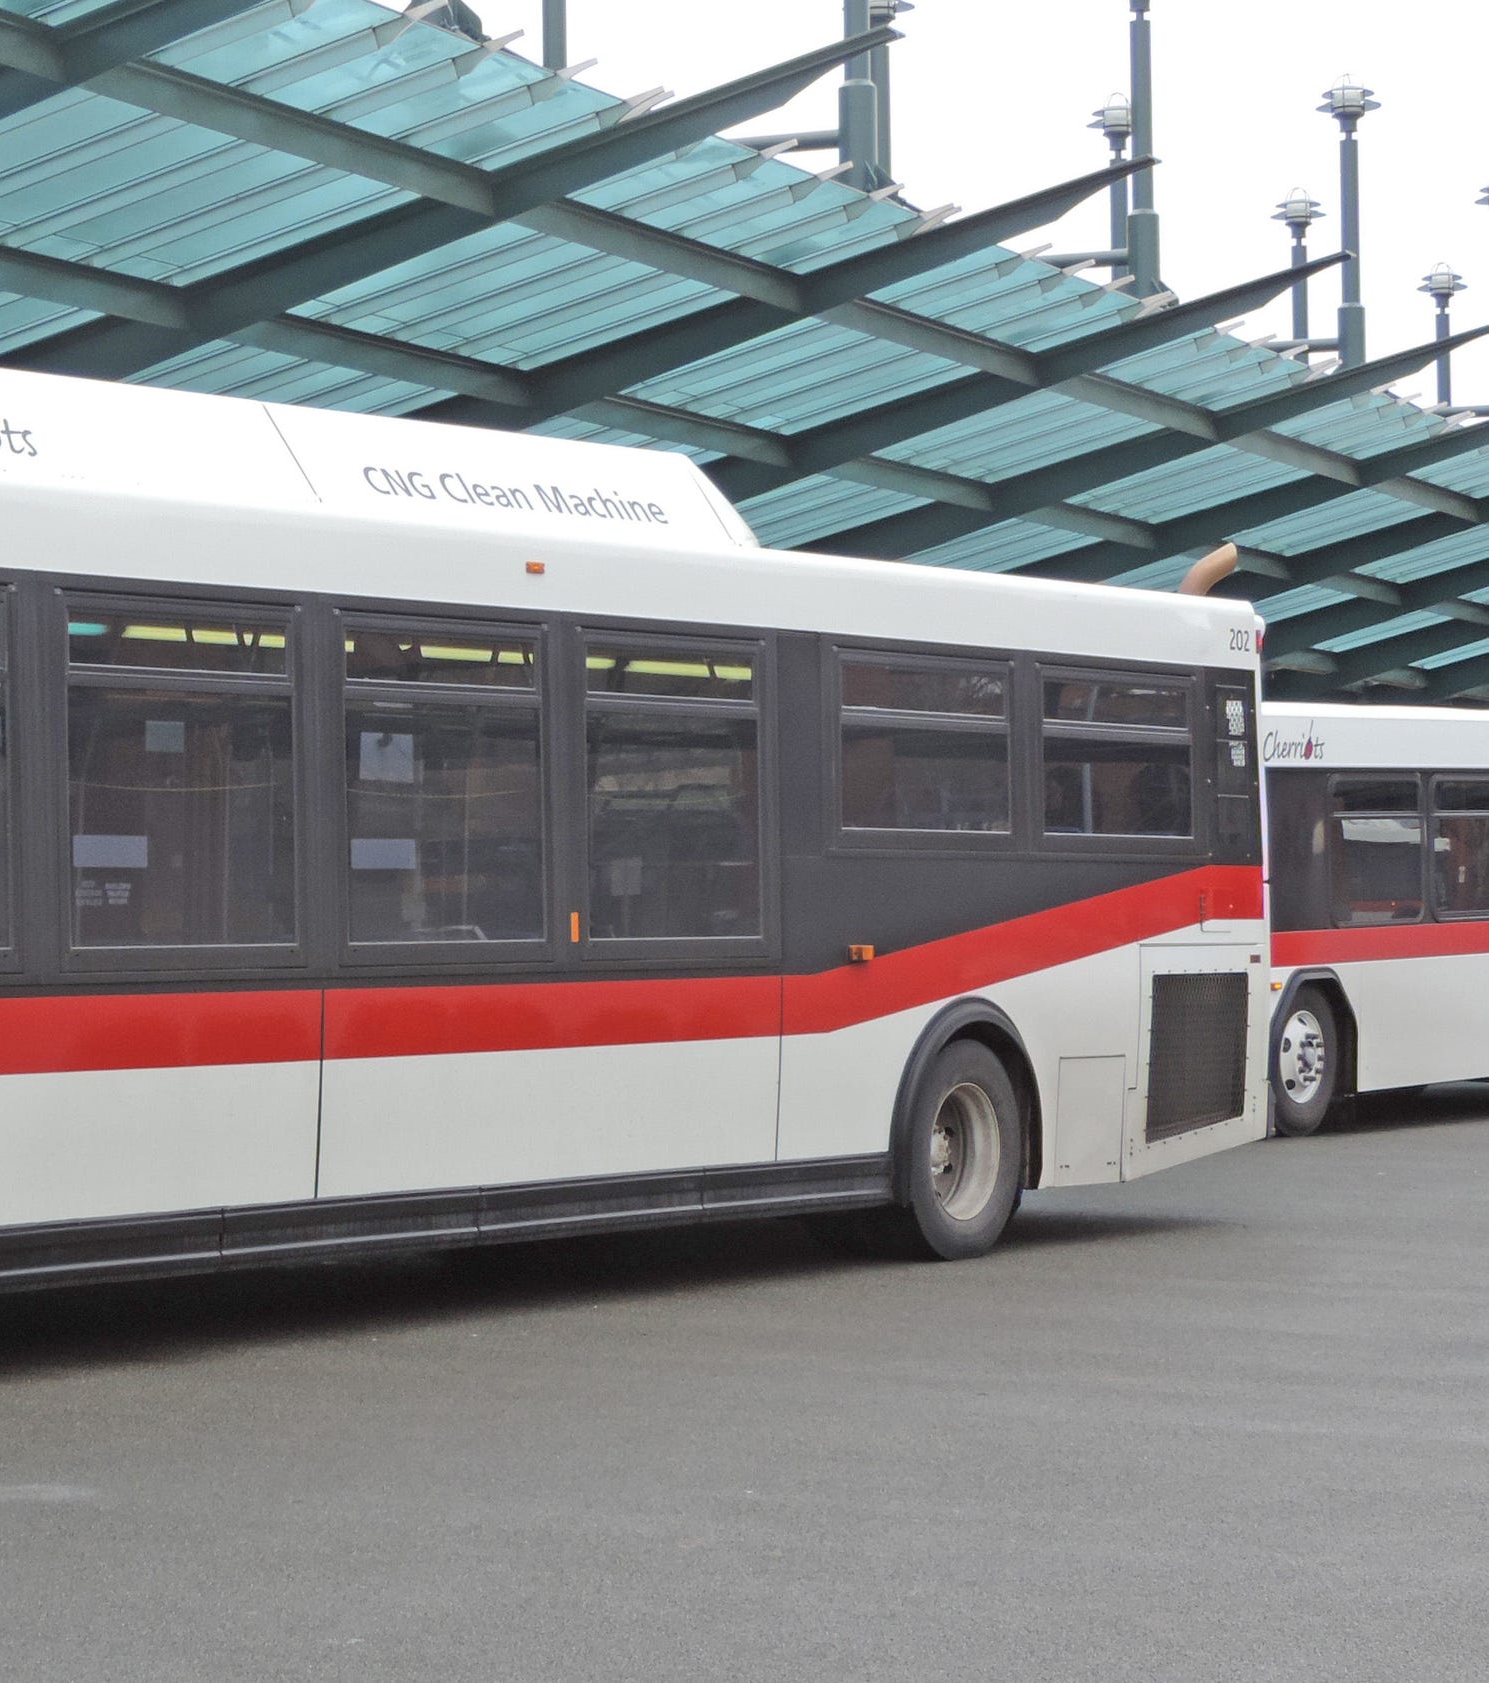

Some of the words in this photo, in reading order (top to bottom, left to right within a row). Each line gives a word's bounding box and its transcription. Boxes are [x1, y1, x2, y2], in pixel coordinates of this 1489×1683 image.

[363, 467, 436, 500] CNG
[439, 473, 534, 510] Clean
[533, 484, 668, 524] Machine
[1229, 629, 1251, 651] 202
[1263, 720, 1326, 762] Cherriots
